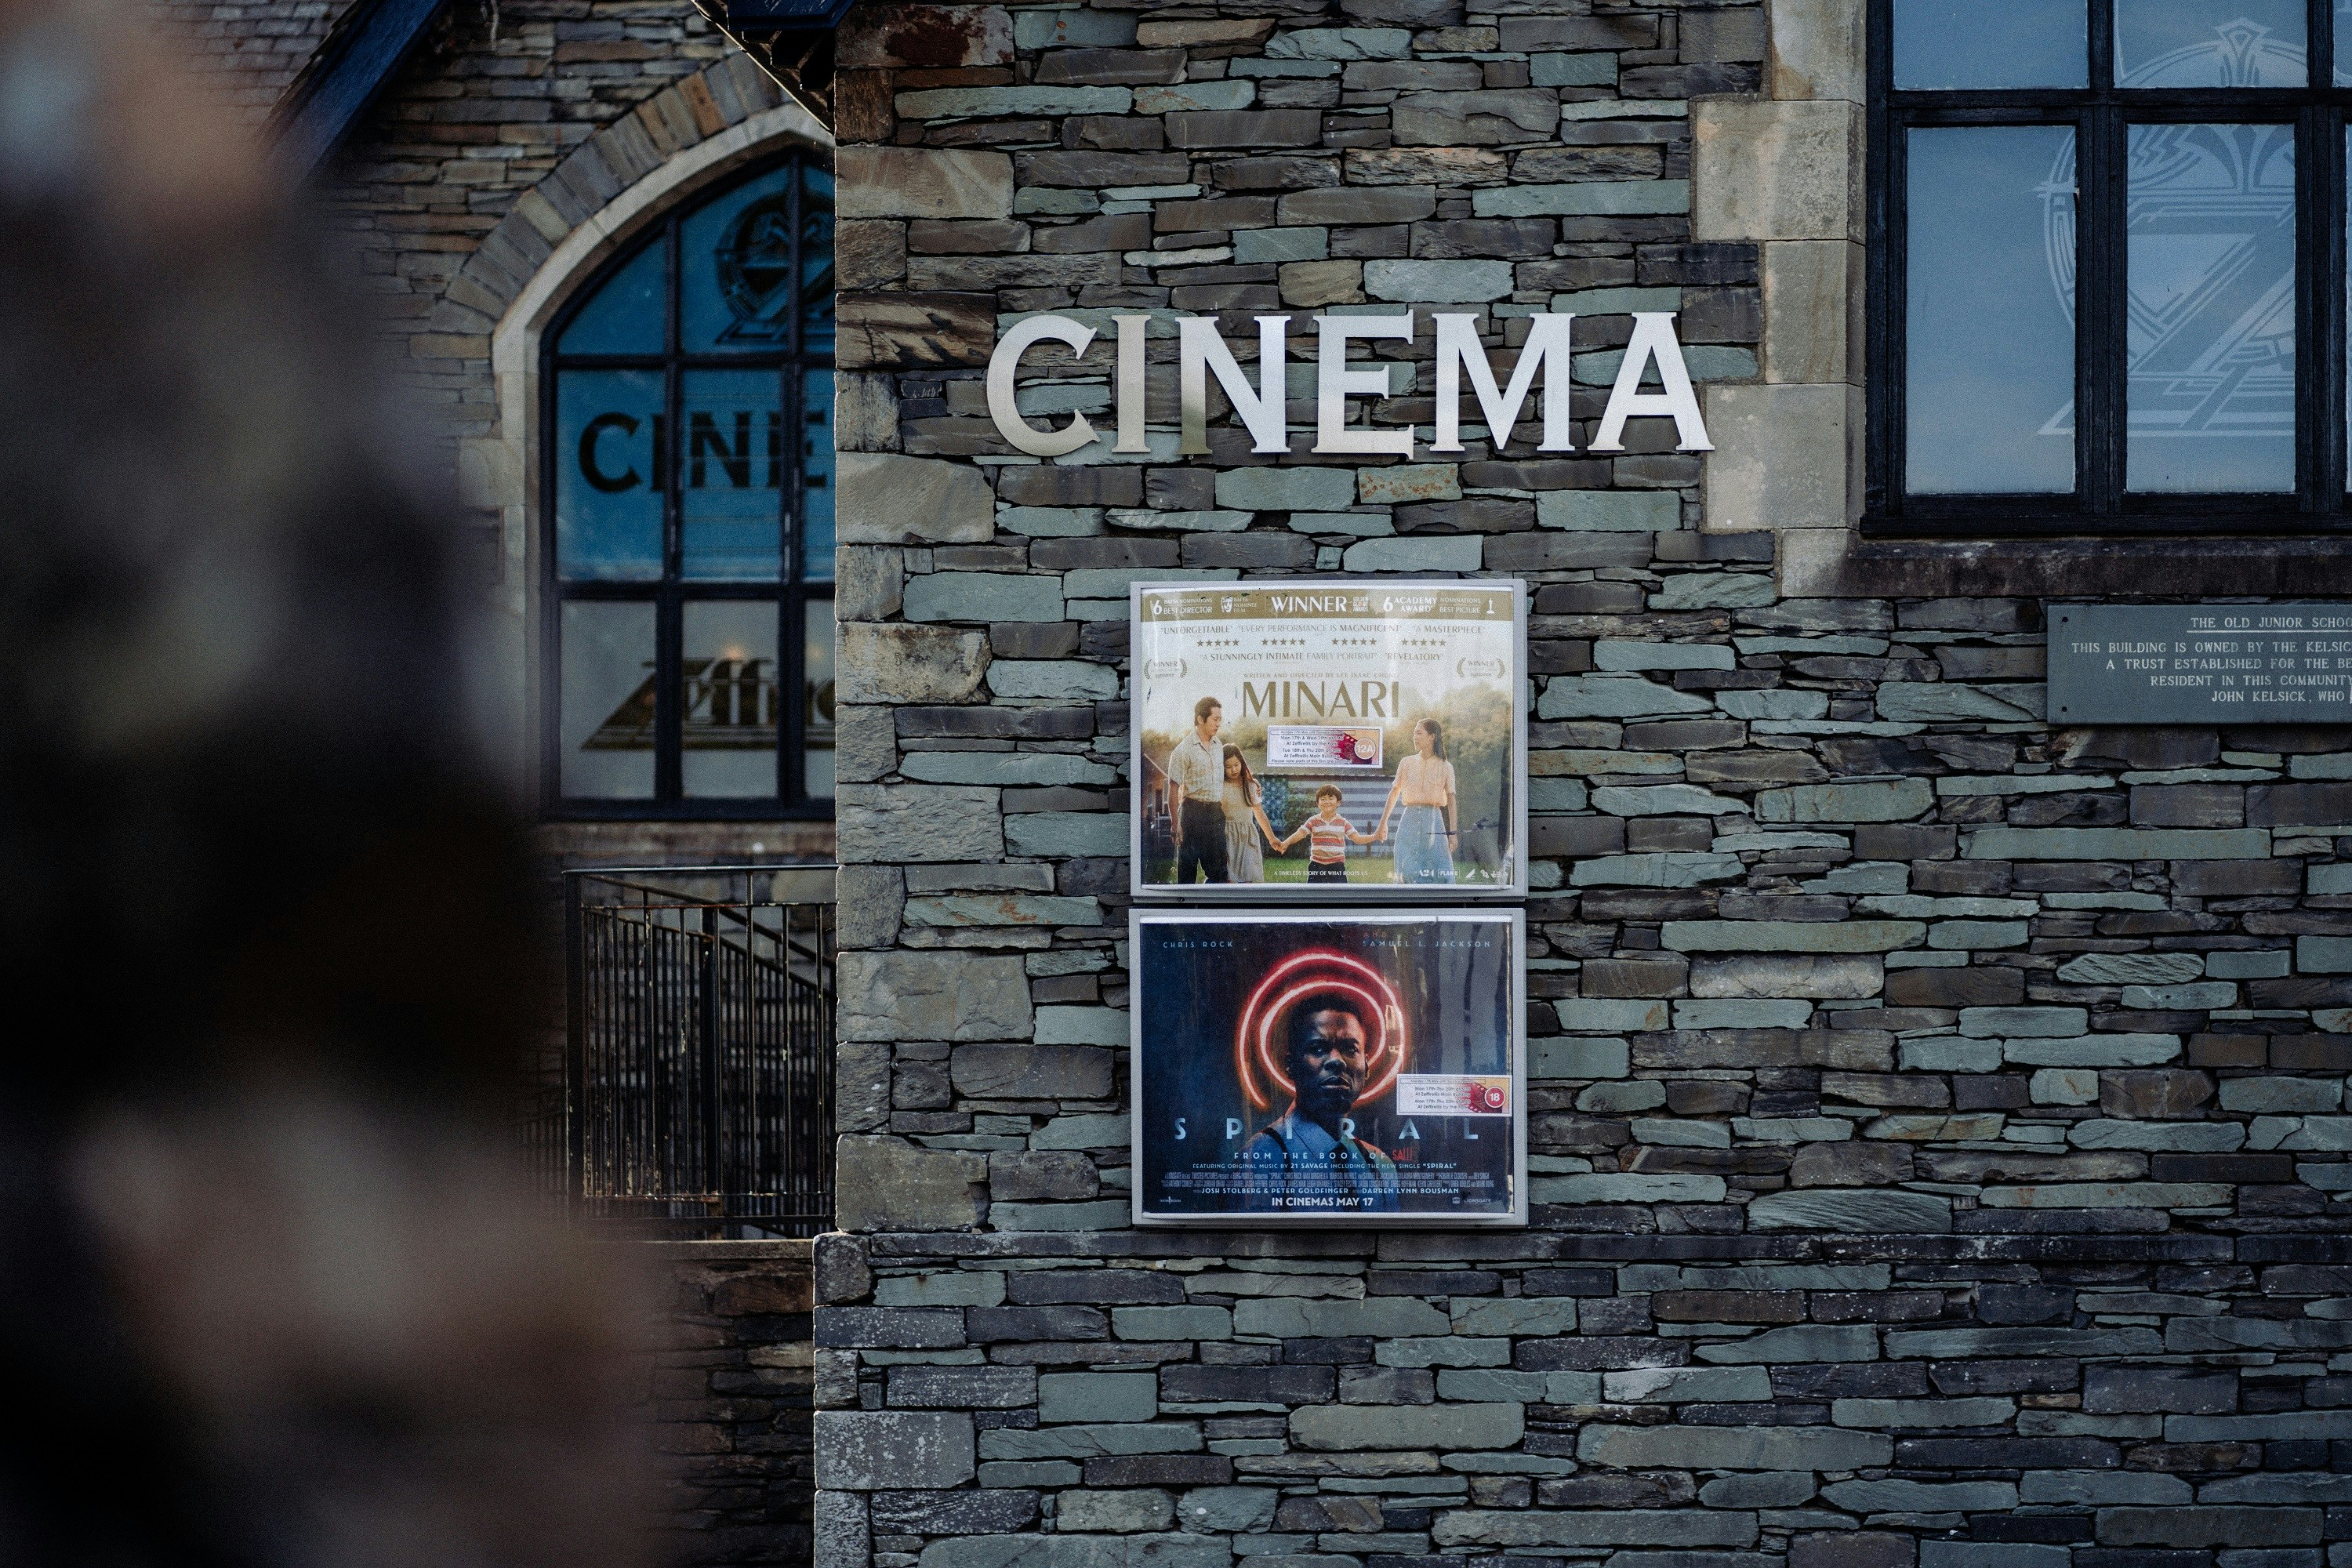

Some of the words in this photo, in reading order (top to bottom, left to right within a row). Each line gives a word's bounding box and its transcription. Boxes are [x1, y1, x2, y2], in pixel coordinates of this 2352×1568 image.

[985, 310, 1715, 459] CINEMA
[1153, 600, 1162, 615] 6
[1271, 597, 1347, 612] WINNER
[1383, 597, 1393, 612] 6
[1163, 606, 1178, 615] BEST
[2190, 617, 2216, 628] THE
[2224, 617, 2250, 628] OLD
[2259, 617, 2303, 628] JUNIOR
[1268, 624, 1327, 633] PERFORMANCE
[1330, 624, 1337, 633] IS
[2071, 642, 2100, 653] THIS
[2108, 642, 2167, 653] BUILDING
[2175, 642, 2187, 653] IS
[2195, 642, 2238, 653] OWNED
[2248, 642, 2263, 653] BY
[2273, 642, 2298, 653] THE
[1210, 652, 1263, 661] STUNNINGLY
[2106, 659, 2115, 670] A
[2124, 659, 2166, 670] TRUST
[2175, 659, 2262, 670] ESTABLISHED
[2270, 659, 2296, 670] FOR
[2304, 659, 2329, 670] THE
[2151, 675, 2212, 686] RESIDENT
[2222, 675, 2234, 686] IN
[2243, 675, 2272, 686] THIS
[1243, 681, 1399, 717] MINARI
[2212, 691, 2244, 702] JOHN
[2318, 691, 2344, 702] WHO
[1490, 1093, 1500, 1102] 18
[1174, 1118, 1479, 1140] SPIRAL
[1272, 1197, 1283, 1207] IN
[1286, 1197, 1334, 1207] CINEMAS
[1336, 1197, 1360, 1207] MAY
[1363, 1197, 1374, 1207] 17
